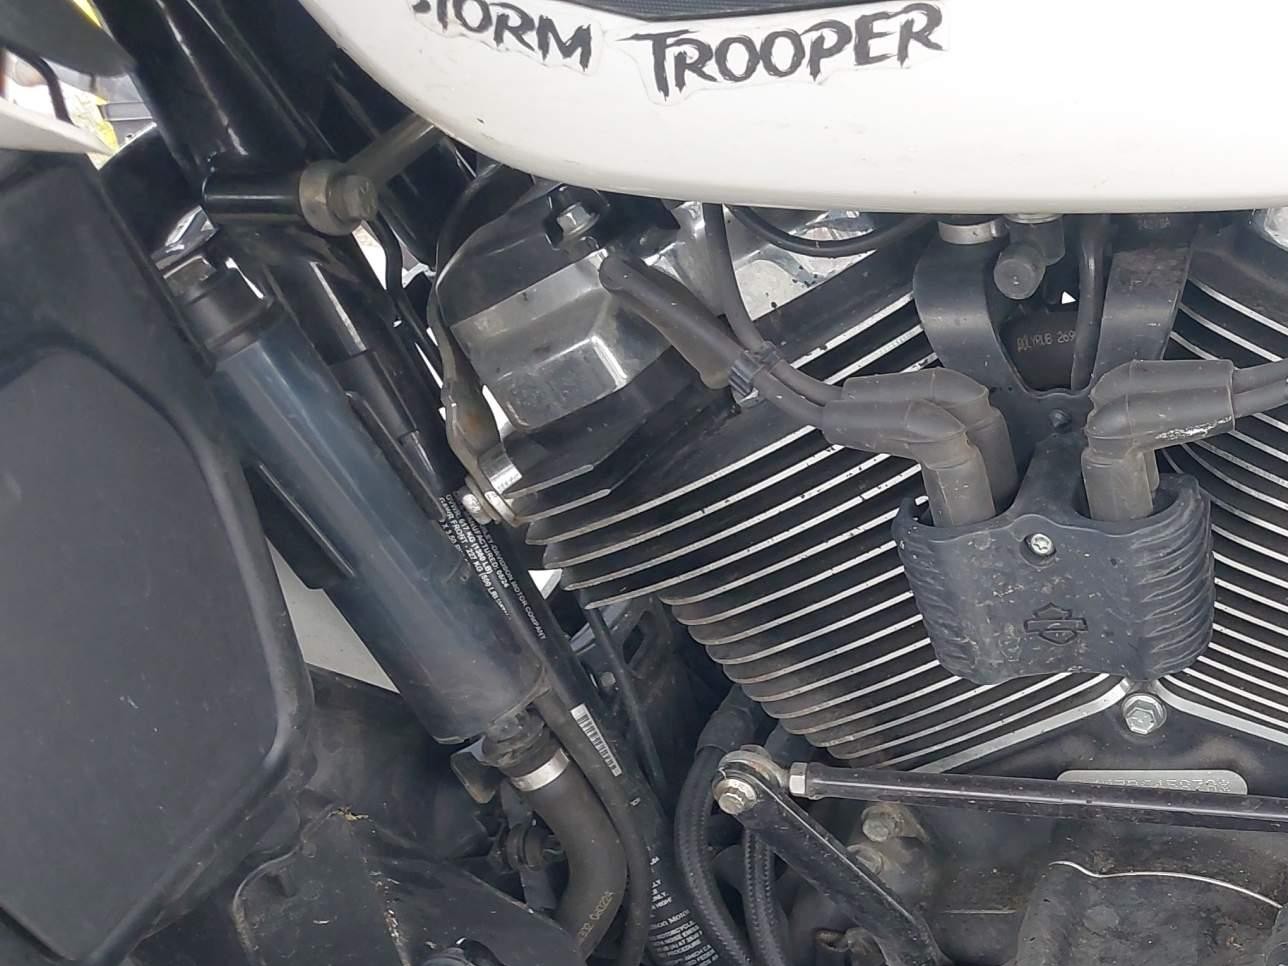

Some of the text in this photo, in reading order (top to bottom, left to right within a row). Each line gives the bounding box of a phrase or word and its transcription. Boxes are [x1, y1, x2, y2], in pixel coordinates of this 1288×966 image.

[412, 0, 948, 102] TORM TROOPER
[450, 518, 469, 543] FRONT
[465, 546, 478, 562] 227
[472, 558, 484, 573] KG
[478, 571, 493, 589] (500
[458, 517, 470, 532] 617
[466, 530, 477, 544] KG
[481, 560, 493, 575] LB)
[510, 580, 528, 607] MOTOR
[524, 606, 547, 640] COMPANY
